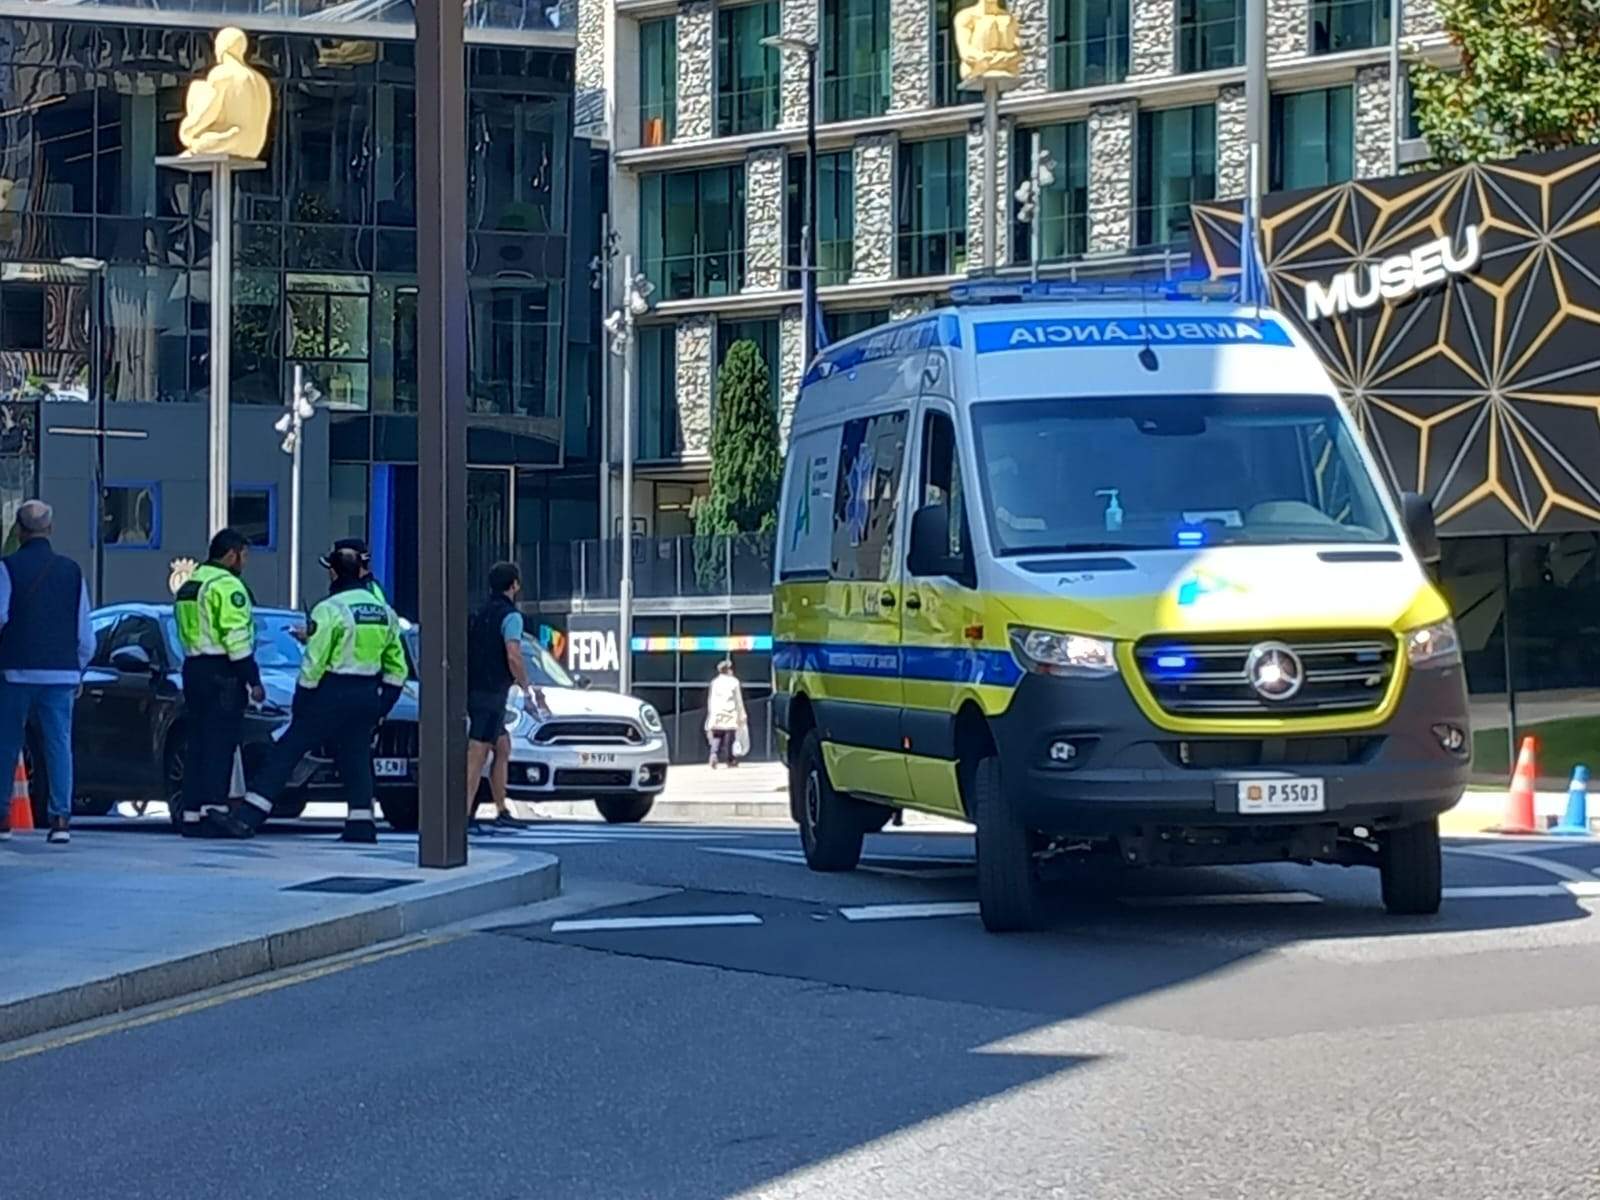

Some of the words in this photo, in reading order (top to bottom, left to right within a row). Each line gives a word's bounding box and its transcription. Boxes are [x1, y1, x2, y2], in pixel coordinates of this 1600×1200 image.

[1304, 224, 1481, 321] MUSEU
[568, 630, 619, 671] FEDA
[1268, 784, 1277, 803] P
[1280, 784, 1319, 803] 5503
